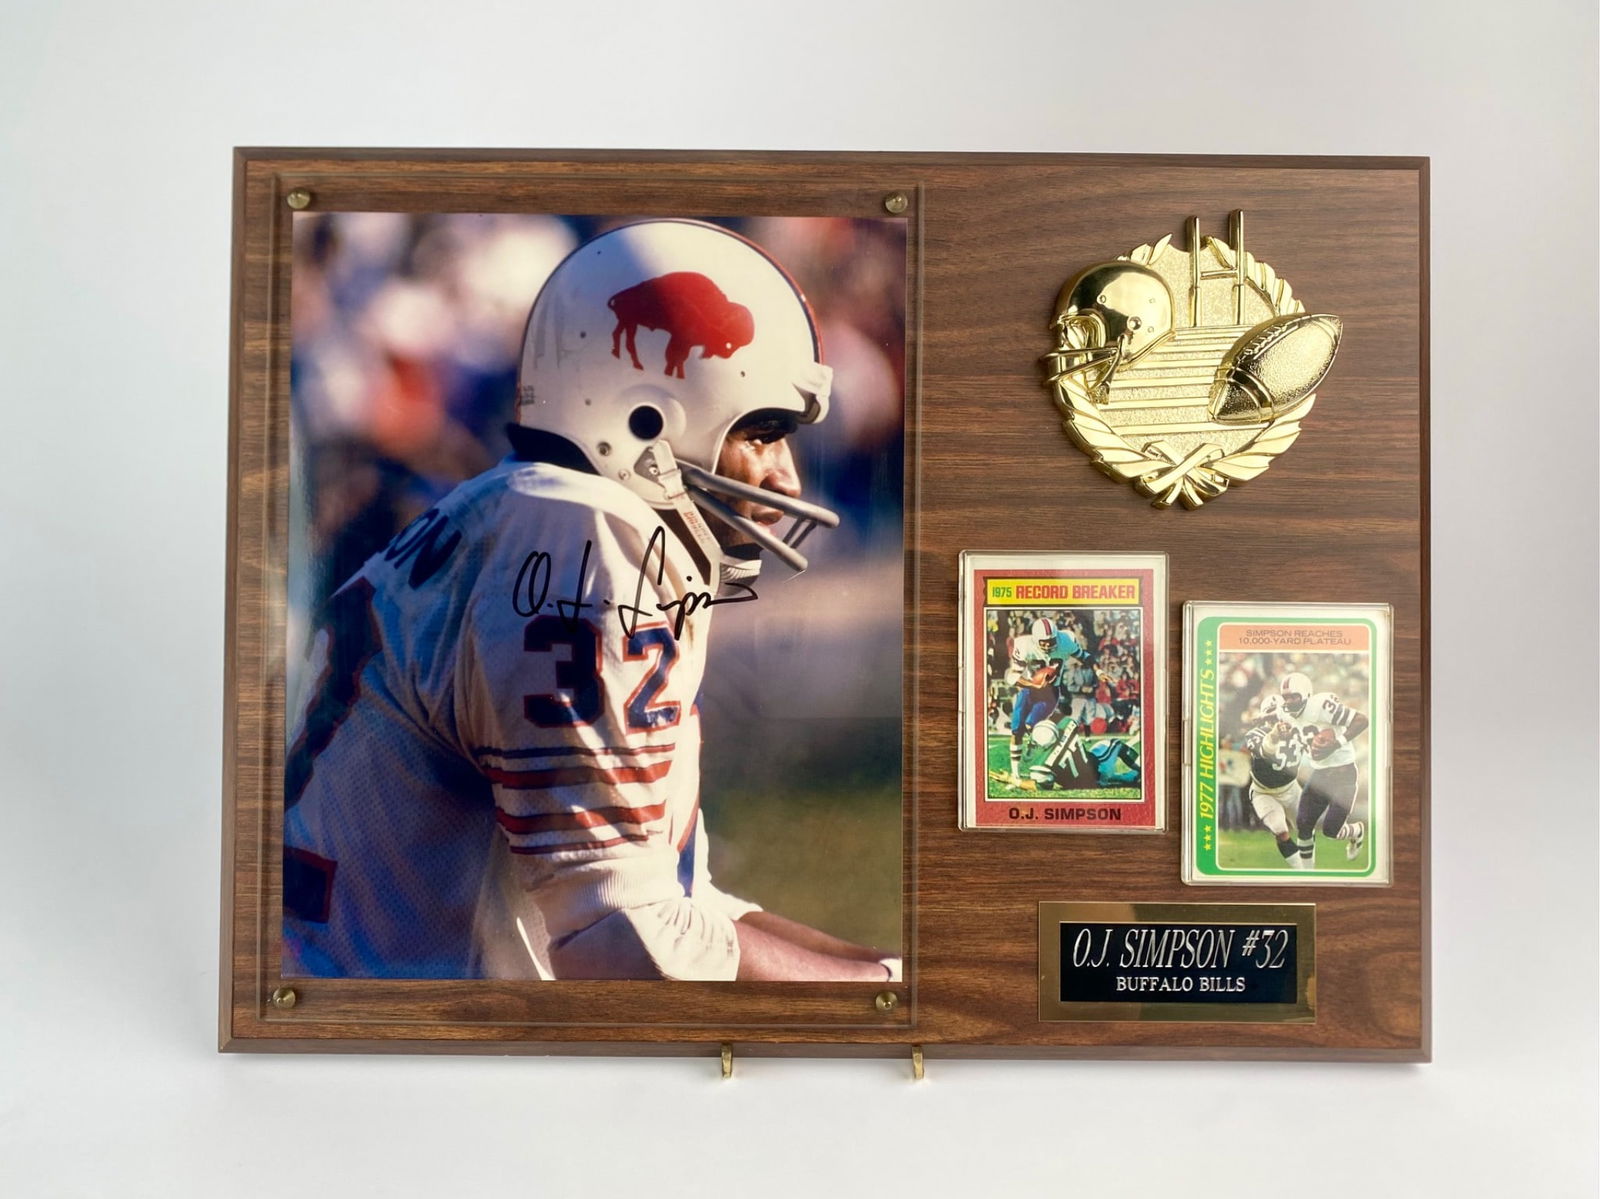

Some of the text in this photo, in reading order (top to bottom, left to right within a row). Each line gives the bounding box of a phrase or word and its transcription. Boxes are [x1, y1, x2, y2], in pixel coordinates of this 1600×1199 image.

[992, 585, 1135, 599] 1975 RECORD BREAKER
[1239, 636, 1351, 645] 10,000-YARD PLATEAU
[1246, 629, 1343, 637] SIMPSON REACHES
[523, 614, 681, 734] 32
[1058, 734, 1089, 778] 77
[1200, 668, 1215, 820] 1977 HIGHLIGHTS
[1272, 739, 1301, 771] 53
[1008, 807, 1122, 820] O.J. SIMPSON
[1073, 928, 1289, 969] O.J. SIMPSON #32
[1116, 976, 1246, 992] BUFFALO BILLS
